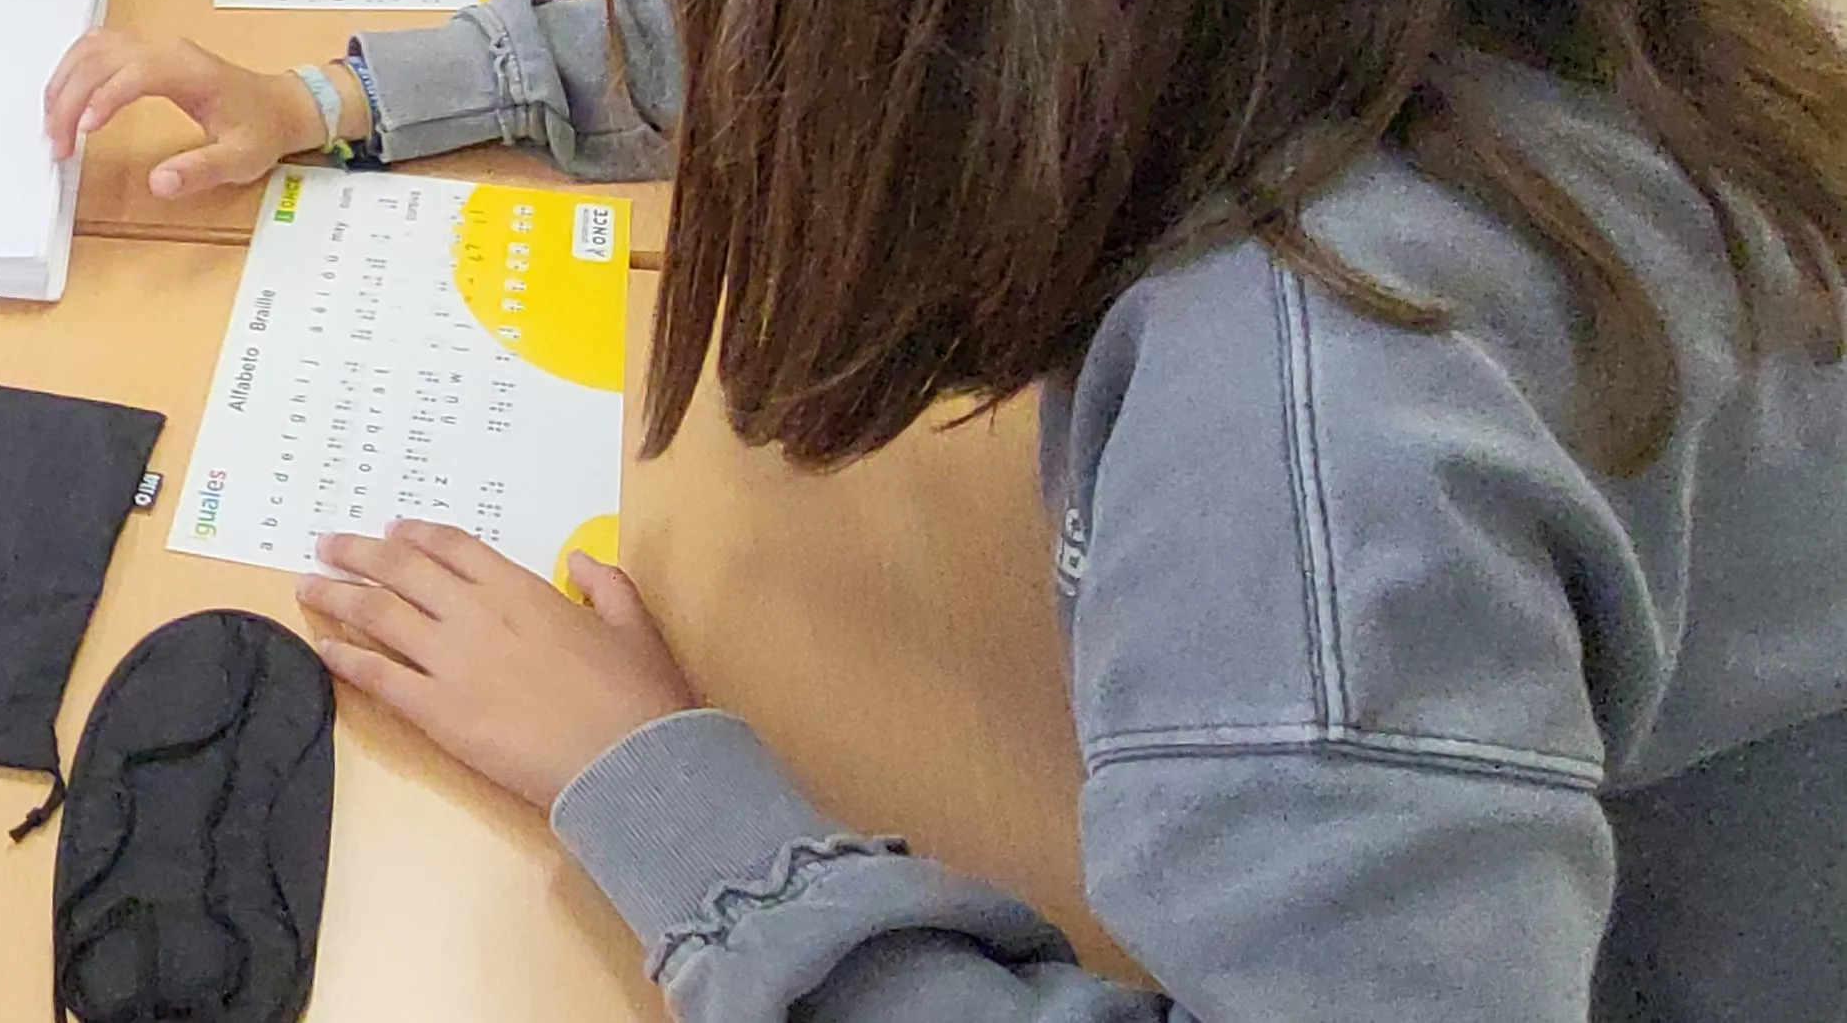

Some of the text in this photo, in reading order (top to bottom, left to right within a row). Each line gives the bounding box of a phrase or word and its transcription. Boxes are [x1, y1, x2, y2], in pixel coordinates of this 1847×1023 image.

[591, 207, 610, 246] ONCE
[228, 289, 276, 413] Alfabeto Braille
[448, 371, 462, 384] w
[195, 469, 228, 543] iguales
[430, 475, 450, 509] y z
